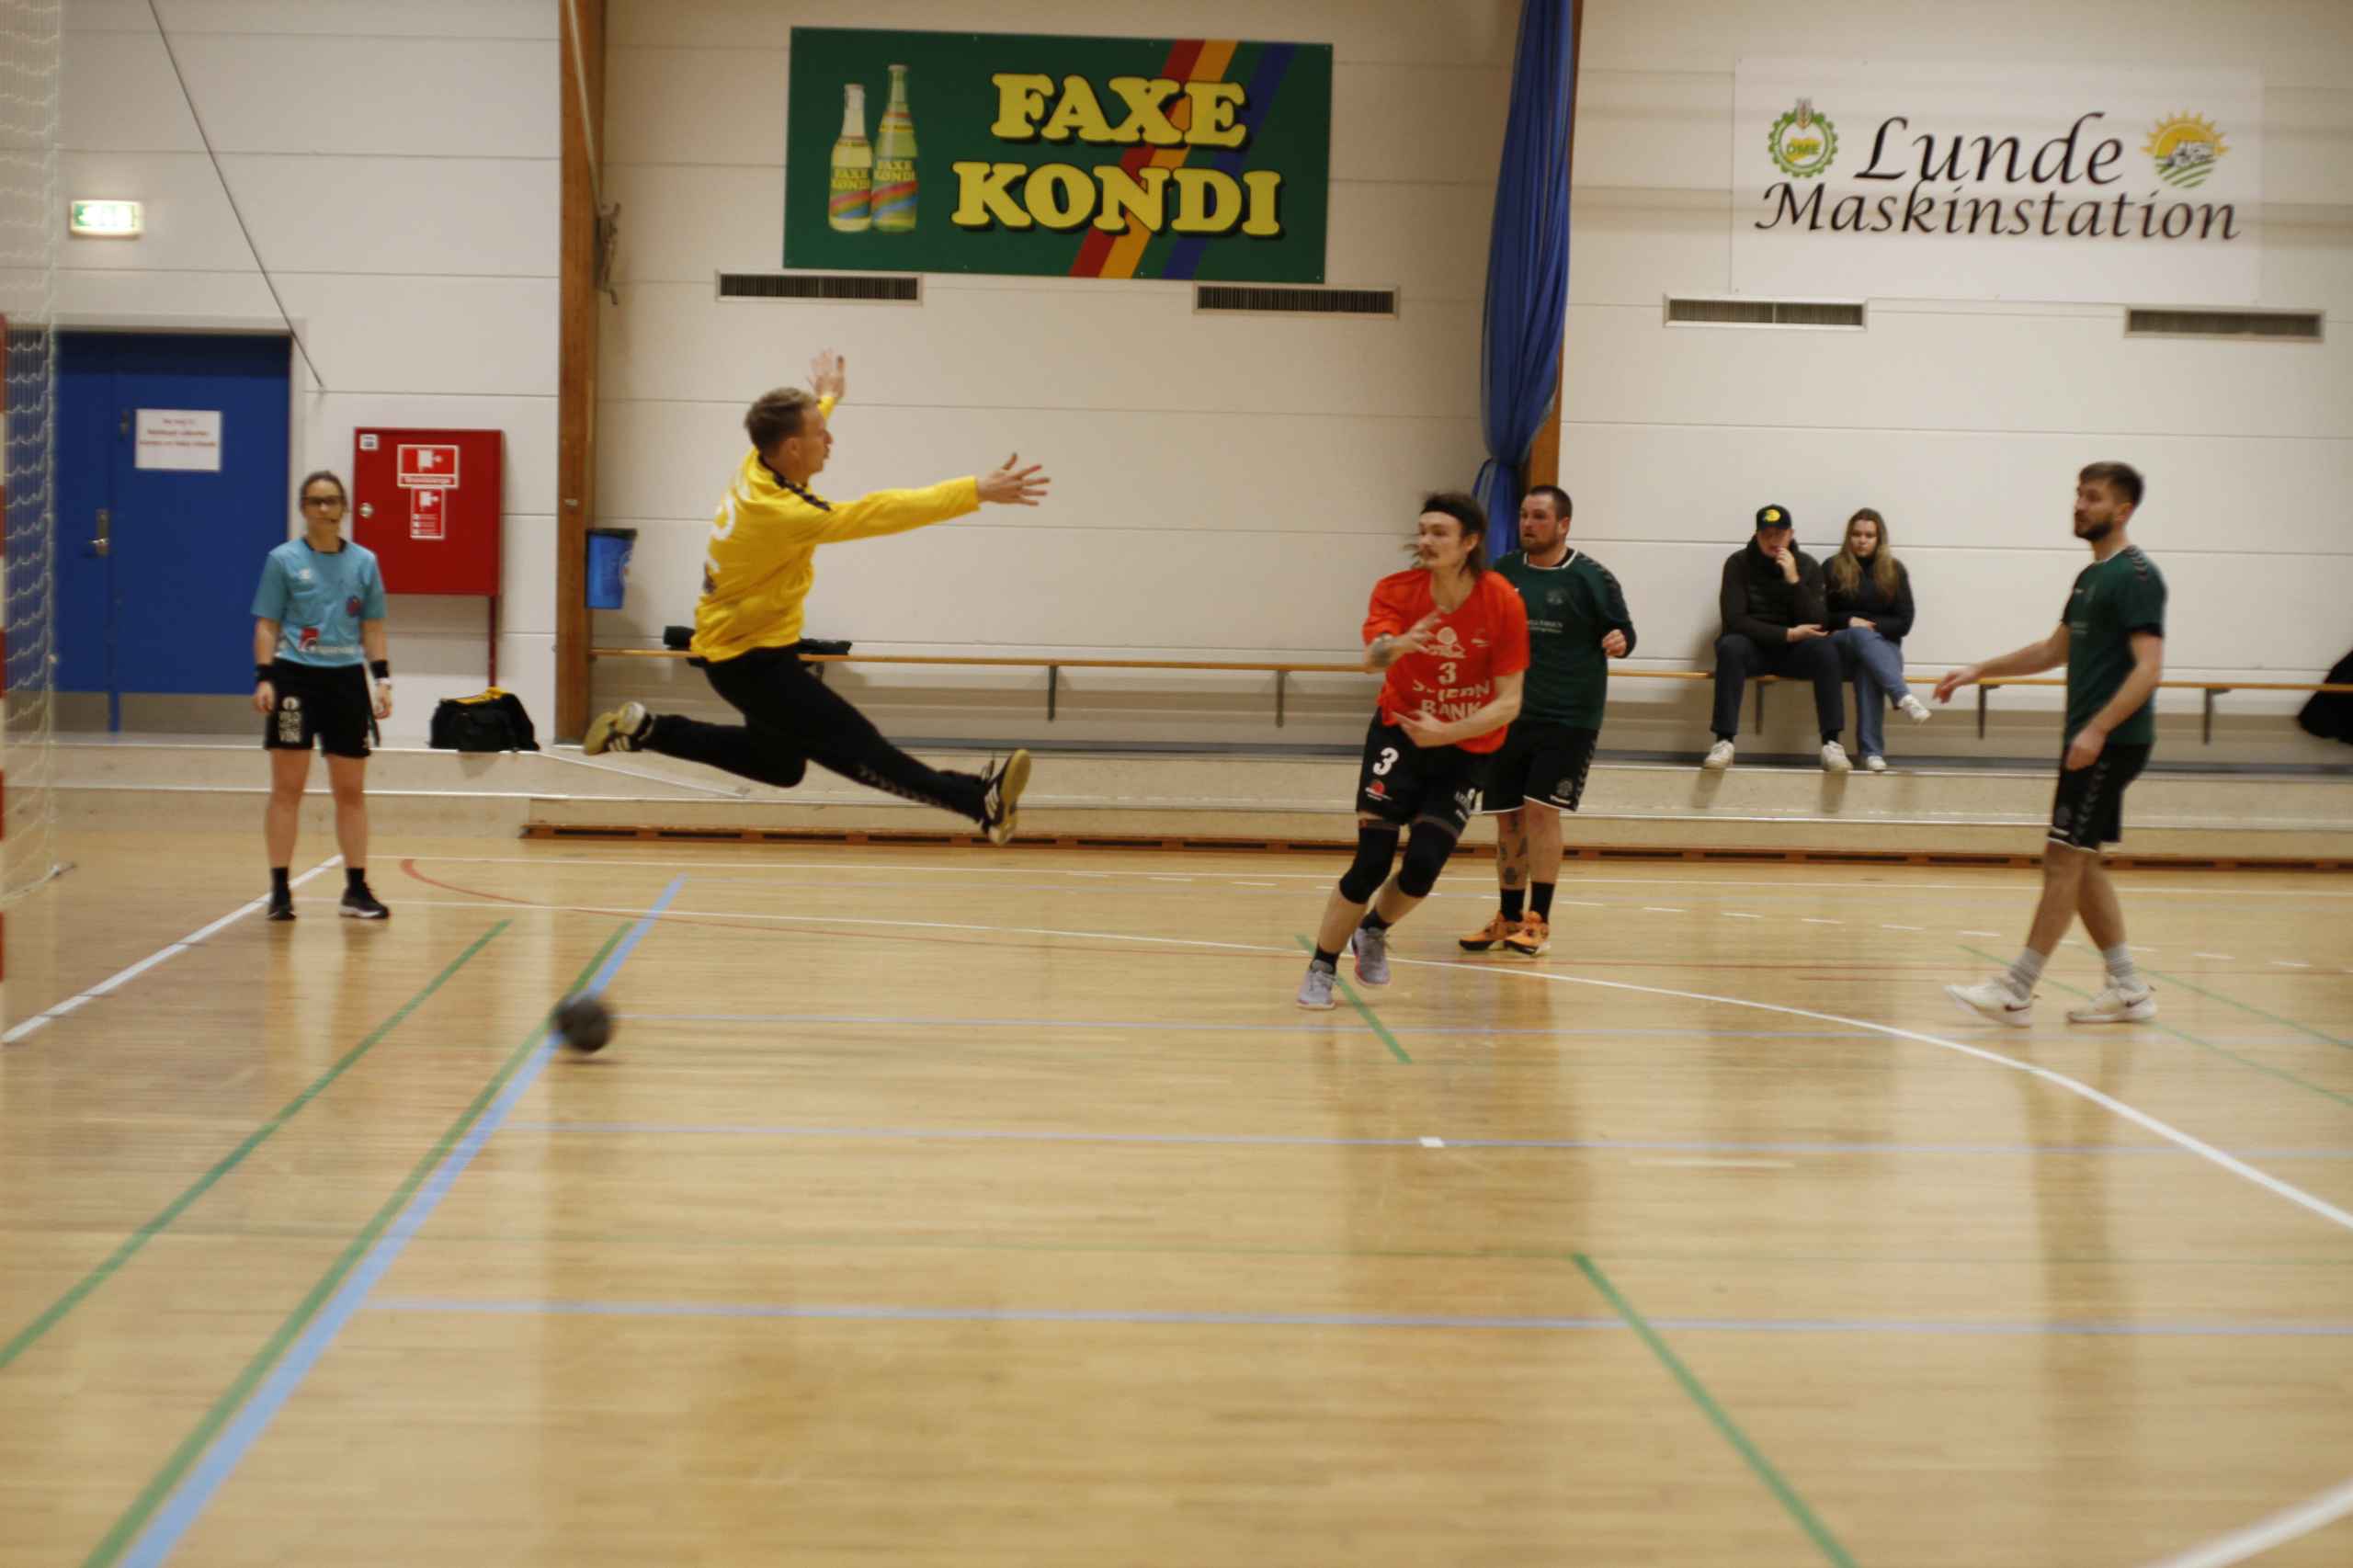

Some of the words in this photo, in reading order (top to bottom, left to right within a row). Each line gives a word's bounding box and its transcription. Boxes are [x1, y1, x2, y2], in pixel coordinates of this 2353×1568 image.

[991, 73, 1248, 148] FAXE
[1853, 111, 2124, 184] Lunde
[950, 161, 1281, 236] KONDI
[1755, 177, 2240, 240] Maskinstation
[1438, 662, 1457, 685] 3
[1372, 746, 1399, 776] 3
